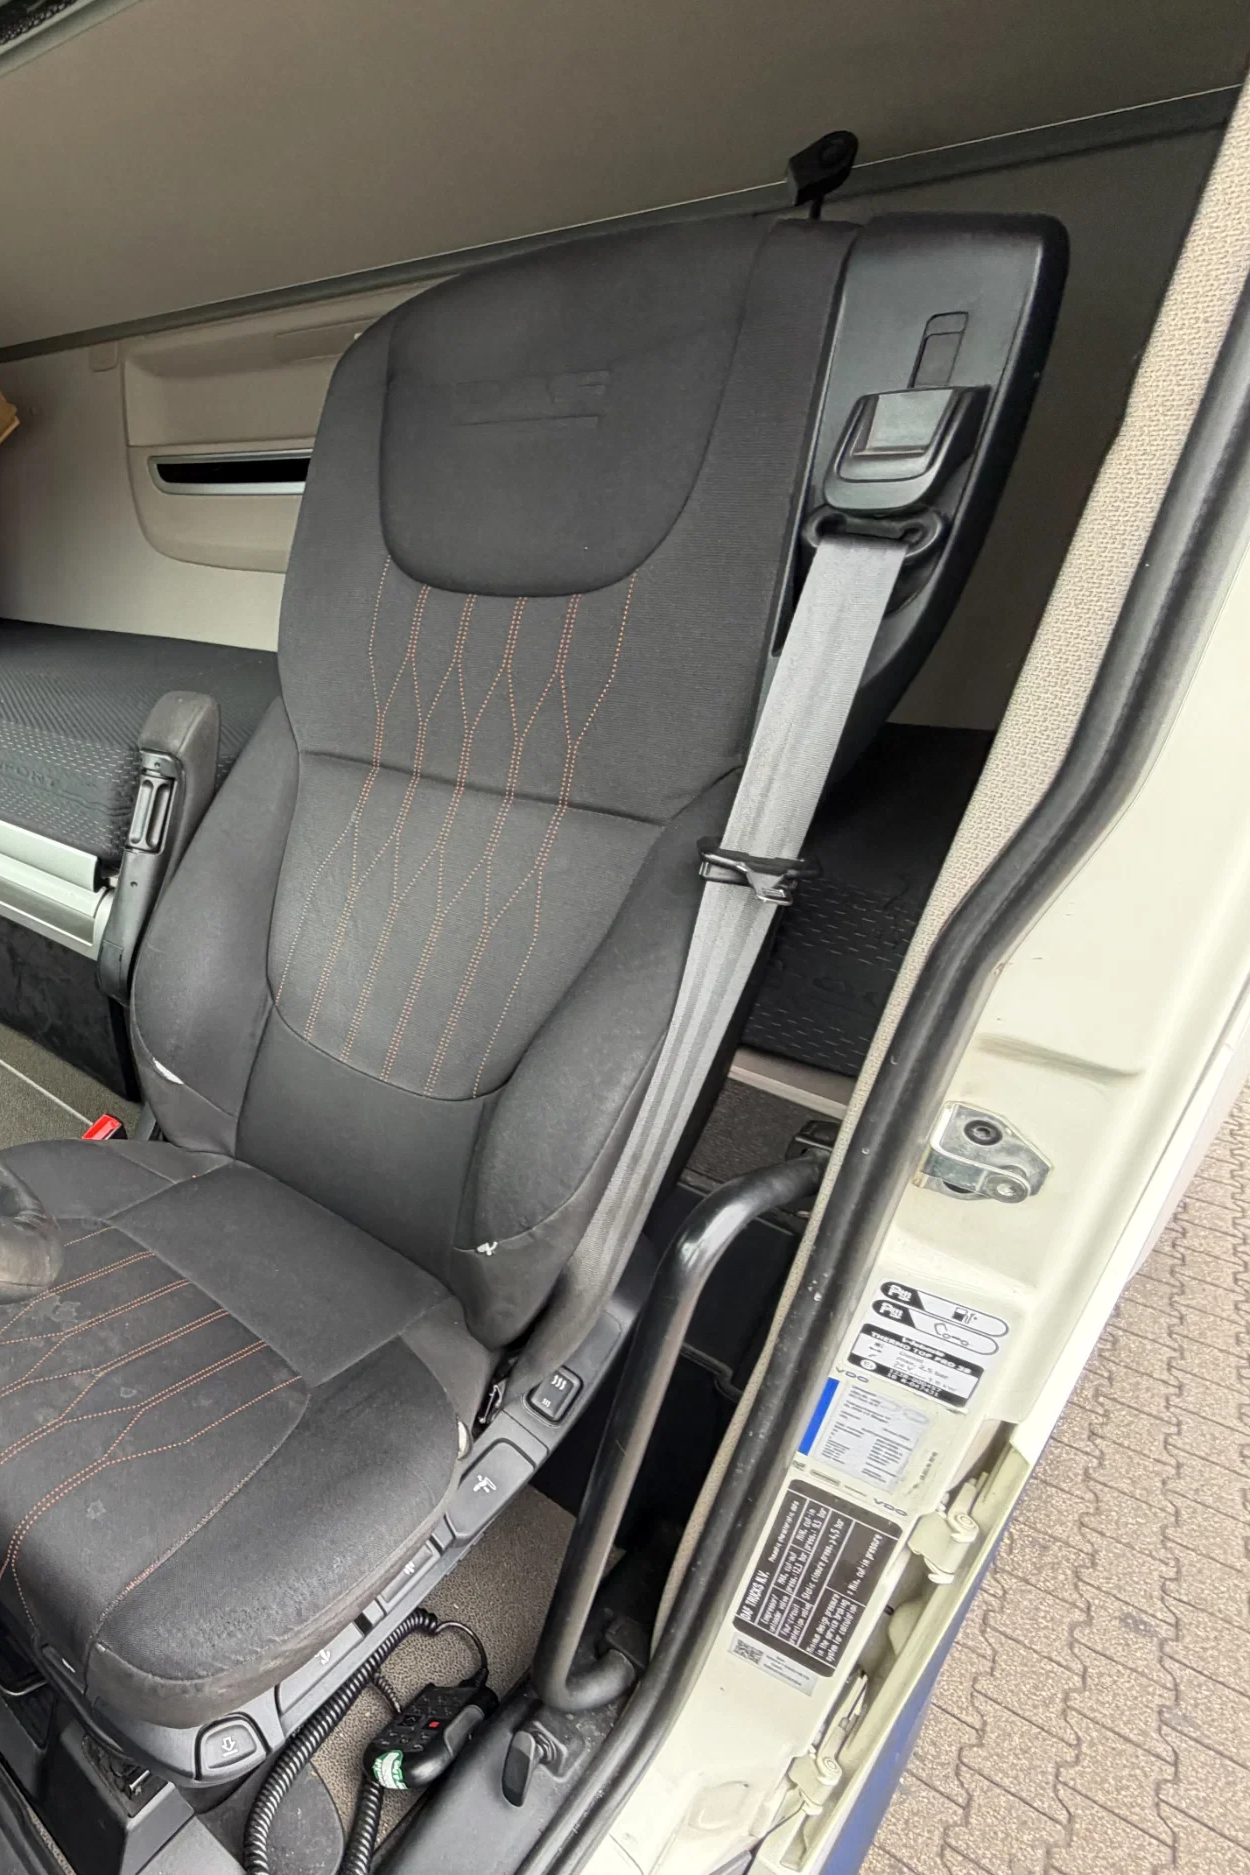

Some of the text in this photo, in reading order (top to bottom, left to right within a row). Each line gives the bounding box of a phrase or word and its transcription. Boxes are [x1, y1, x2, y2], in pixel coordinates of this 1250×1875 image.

[869, 1331, 912, 1351] THERMO
[911, 1347, 933, 1359] TOP
[933, 1355, 956, 1368] PRO
[833, 1365, 870, 1384] VDO
[871, 1496, 909, 1517] VDO
[831, 1515, 845, 1530] bar
[862, 1530, 885, 1561] pressure
[743, 1581, 765, 1608] TRUCKS
[738, 1603, 755, 1621] DAF
